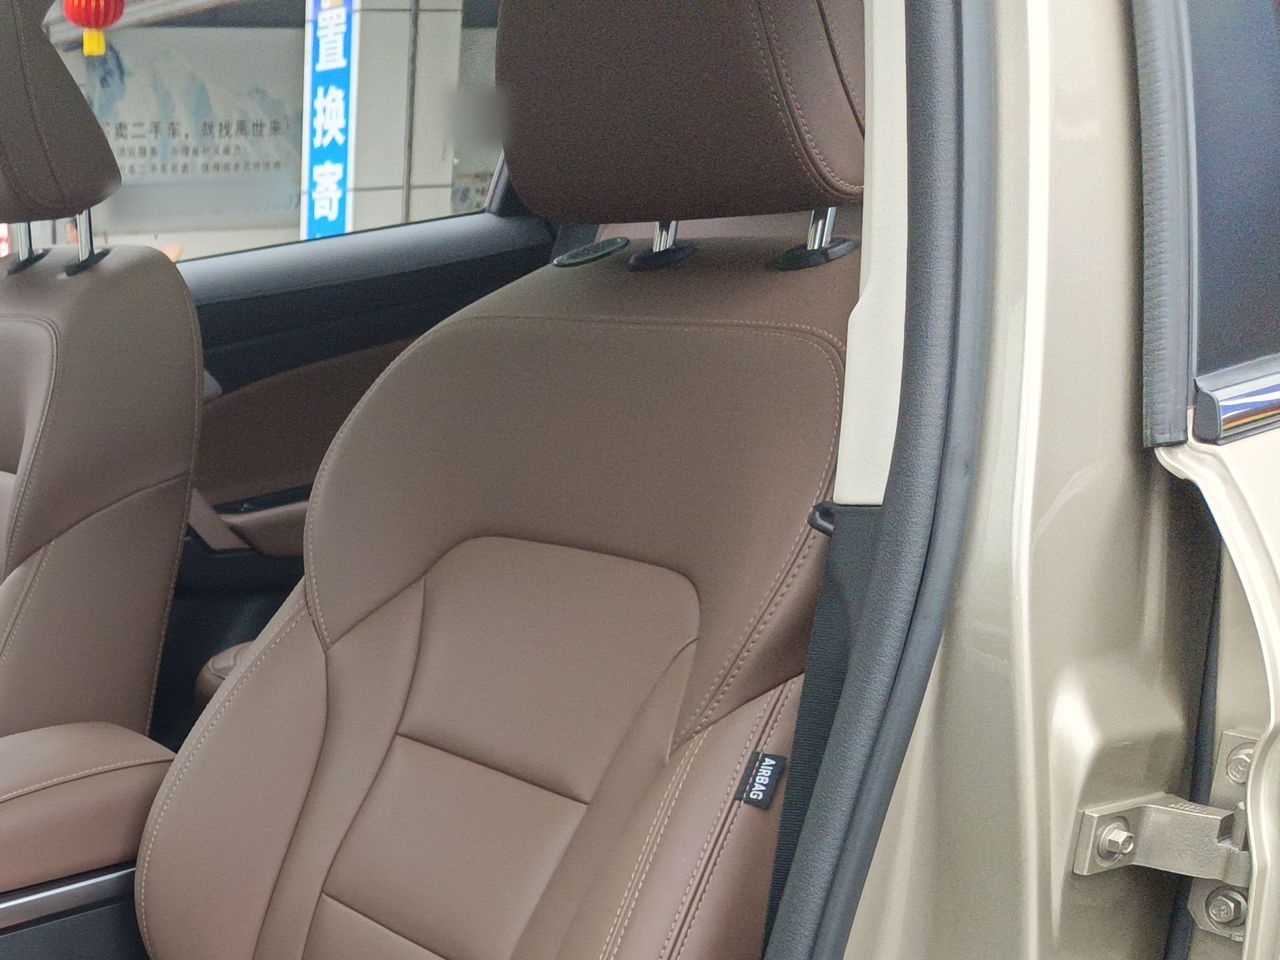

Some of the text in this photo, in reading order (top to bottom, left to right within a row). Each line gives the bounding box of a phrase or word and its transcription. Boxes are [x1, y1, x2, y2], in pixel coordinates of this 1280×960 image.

[310, 6, 349, 238] 置换寄
[750, 757, 776, 800] AIRBAG
